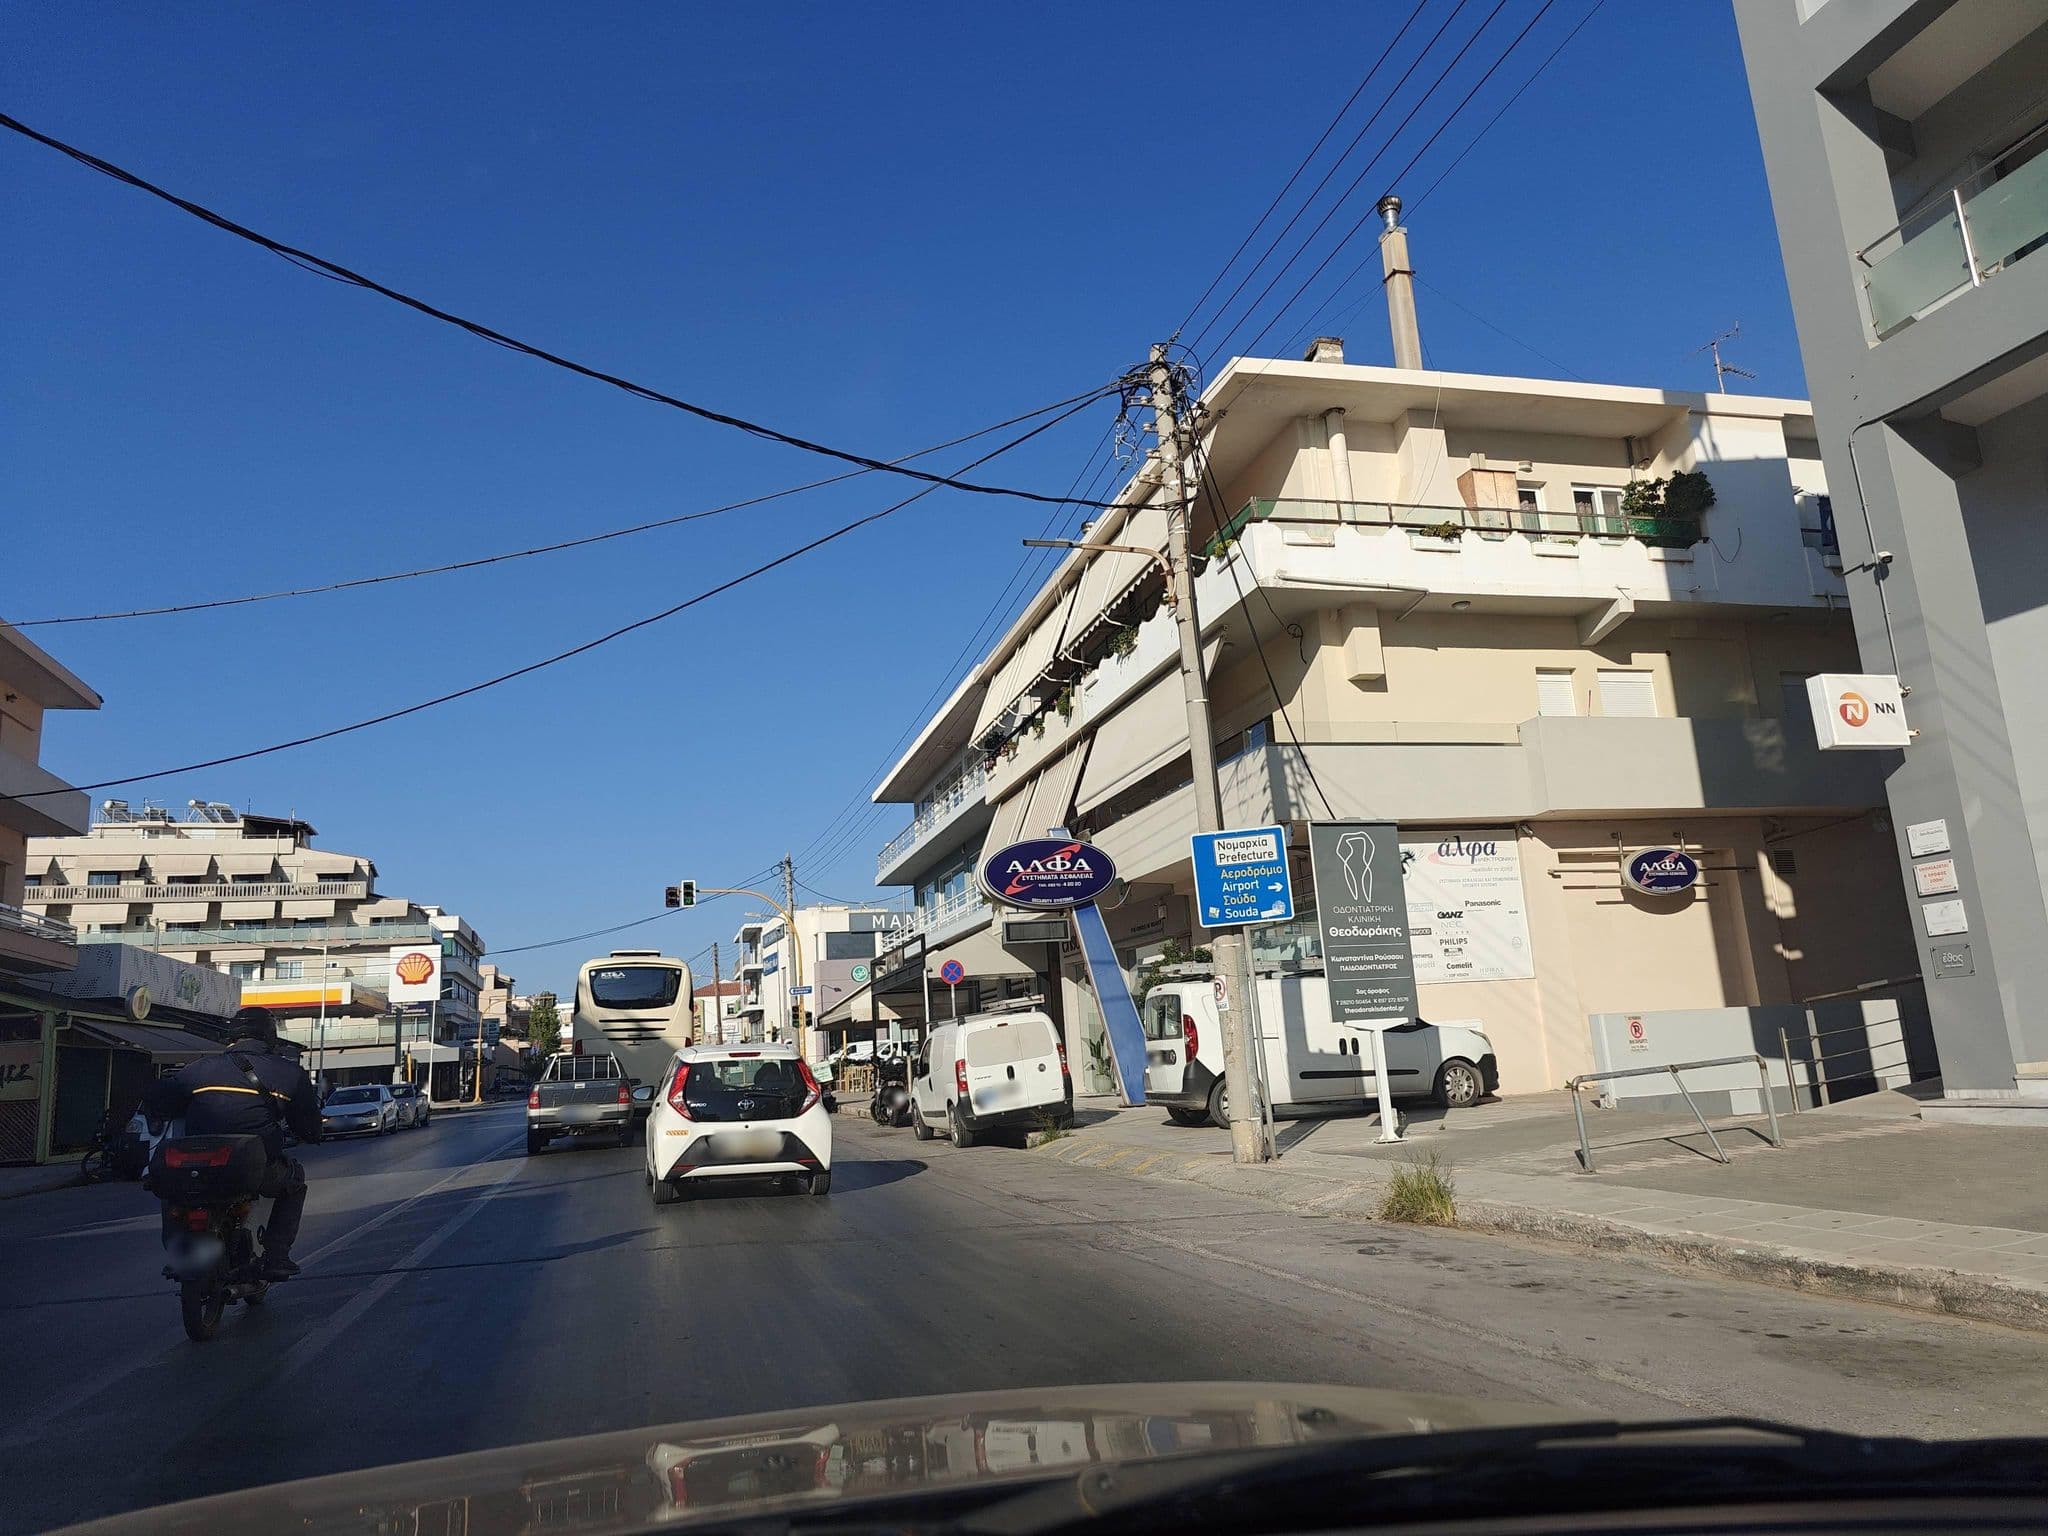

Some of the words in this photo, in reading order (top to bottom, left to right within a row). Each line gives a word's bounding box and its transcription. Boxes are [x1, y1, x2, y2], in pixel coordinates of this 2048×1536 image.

[1874, 703, 1896, 714] NN
[1217, 838, 1268, 851] Νομαρχία
[1437, 835, 1497, 864] άλφα
[1219, 850, 1274, 863] Prefecture
[1006, 856, 1091, 873] ΑΛΦΑ
[1640, 860, 1686, 871] ΑΛΦΑ
[1060, 872, 1094, 880] ΑΣΦΑΛΕΙΑΣ
[1221, 866, 1283, 880] Αεροδρόμιο
[1222, 880, 1259, 892] Airport
[1223, 893, 1256, 906] Σούδα
[1464, 899, 1501, 907] Panasonic
[1225, 906, 1259, 919] Souda
[1333, 905, 1394, 914] ΟΔΟΝΤΙΑΤΡΙΚΗ
[1437, 911, 1464, 919] GANZ
[1348, 915, 1381, 923] ΚΛΙΝΙΚΗ
[1329, 925, 1402, 938] Θεοδωράκης
[1440, 938, 1468, 946] PHILIPS
[1330, 954, 1374, 963] Κωνσταντίνα
[1340, 963, 1398, 972] ΠΑΙΔΟΔΟΝΤΙΑΤΡΟΣ
[1446, 961, 1473, 970] Comelit
